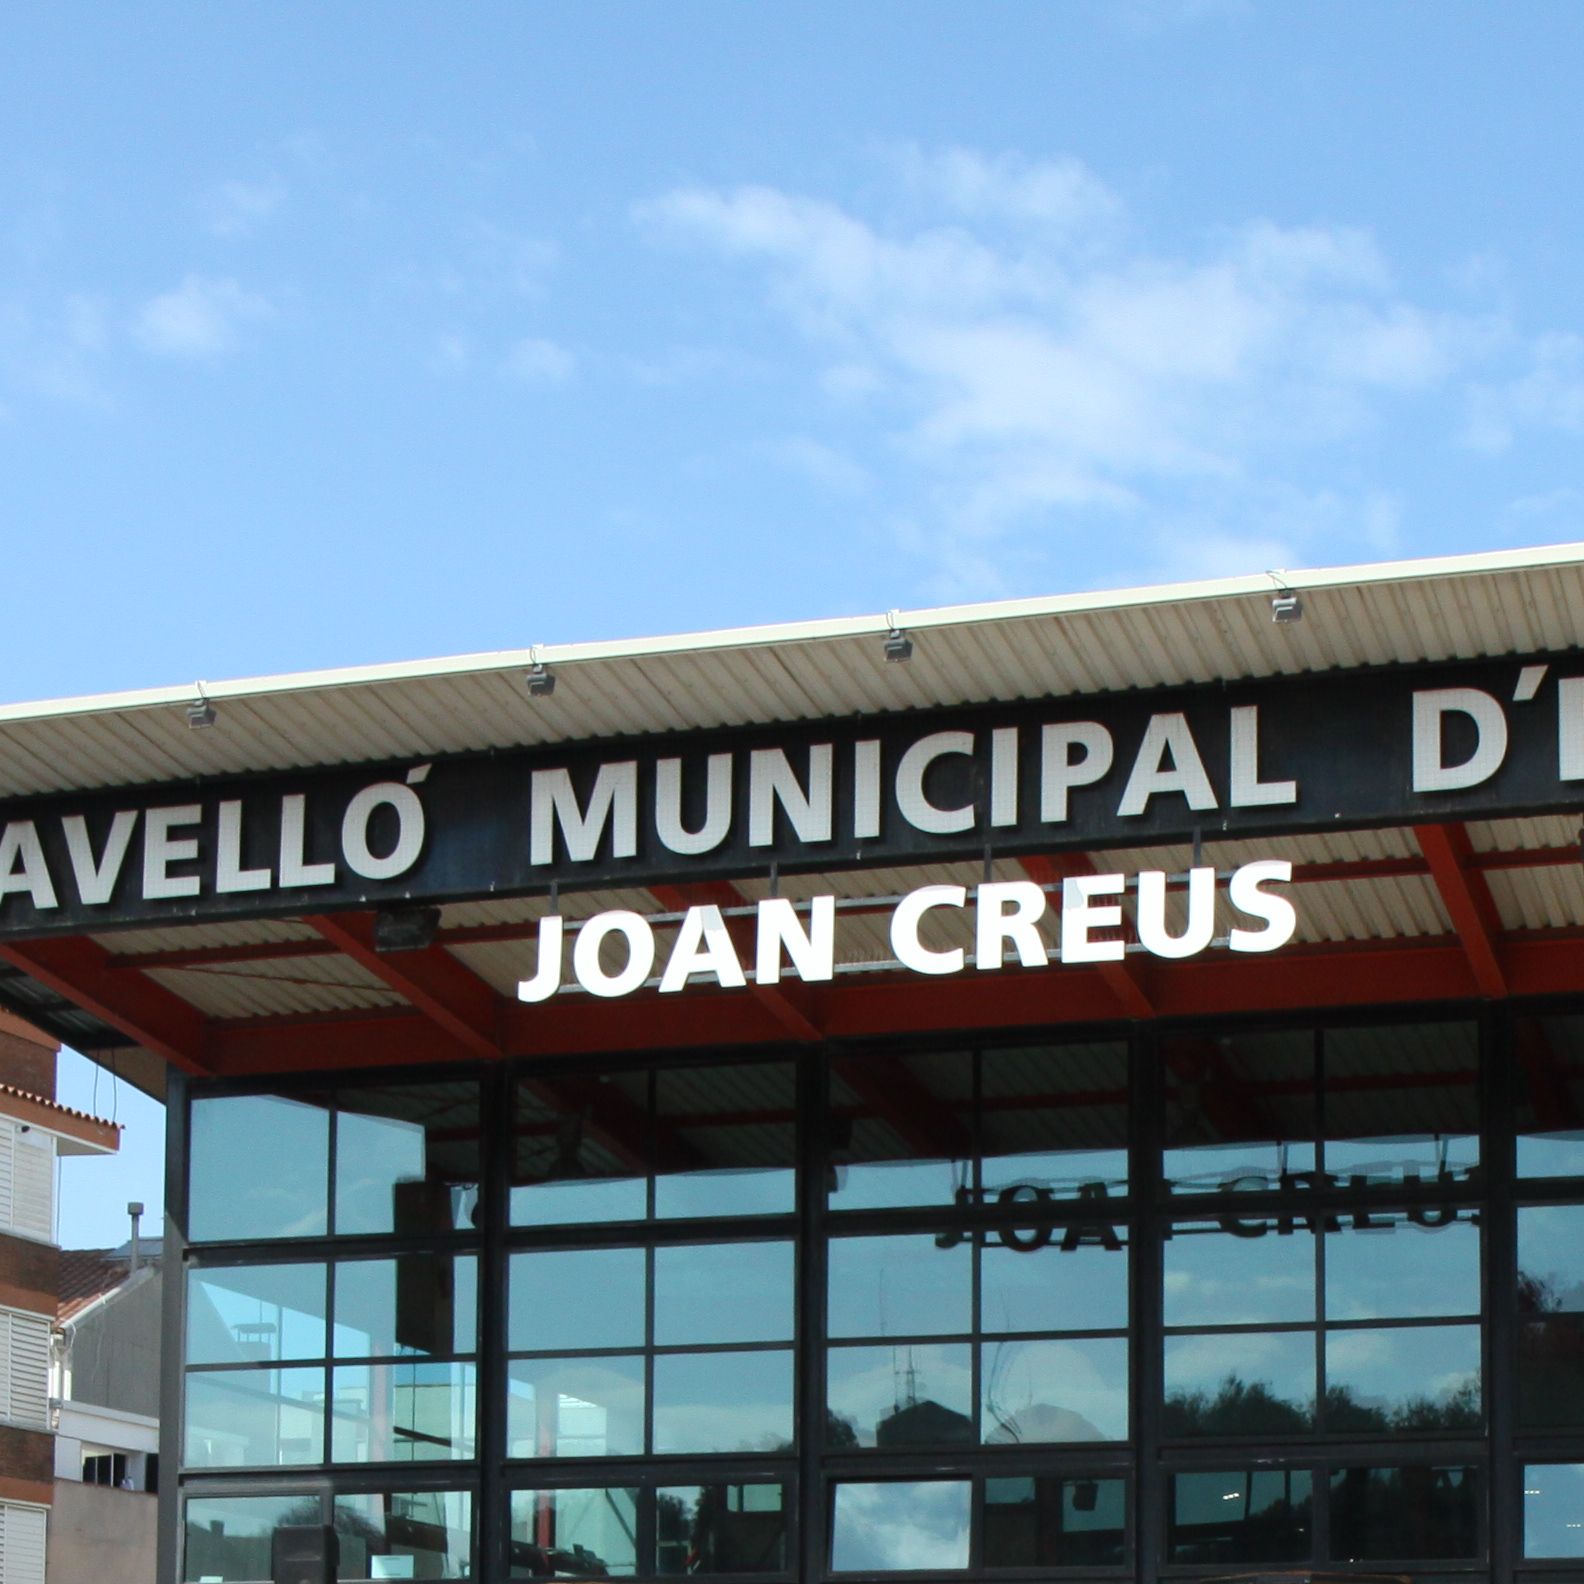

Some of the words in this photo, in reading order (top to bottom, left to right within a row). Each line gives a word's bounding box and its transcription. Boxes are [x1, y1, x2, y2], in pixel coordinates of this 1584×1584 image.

[529, 706, 1297, 866] MUNICIPAL
[518, 896, 835, 1003] JOAN
[890, 861, 1297, 975] CREUS
